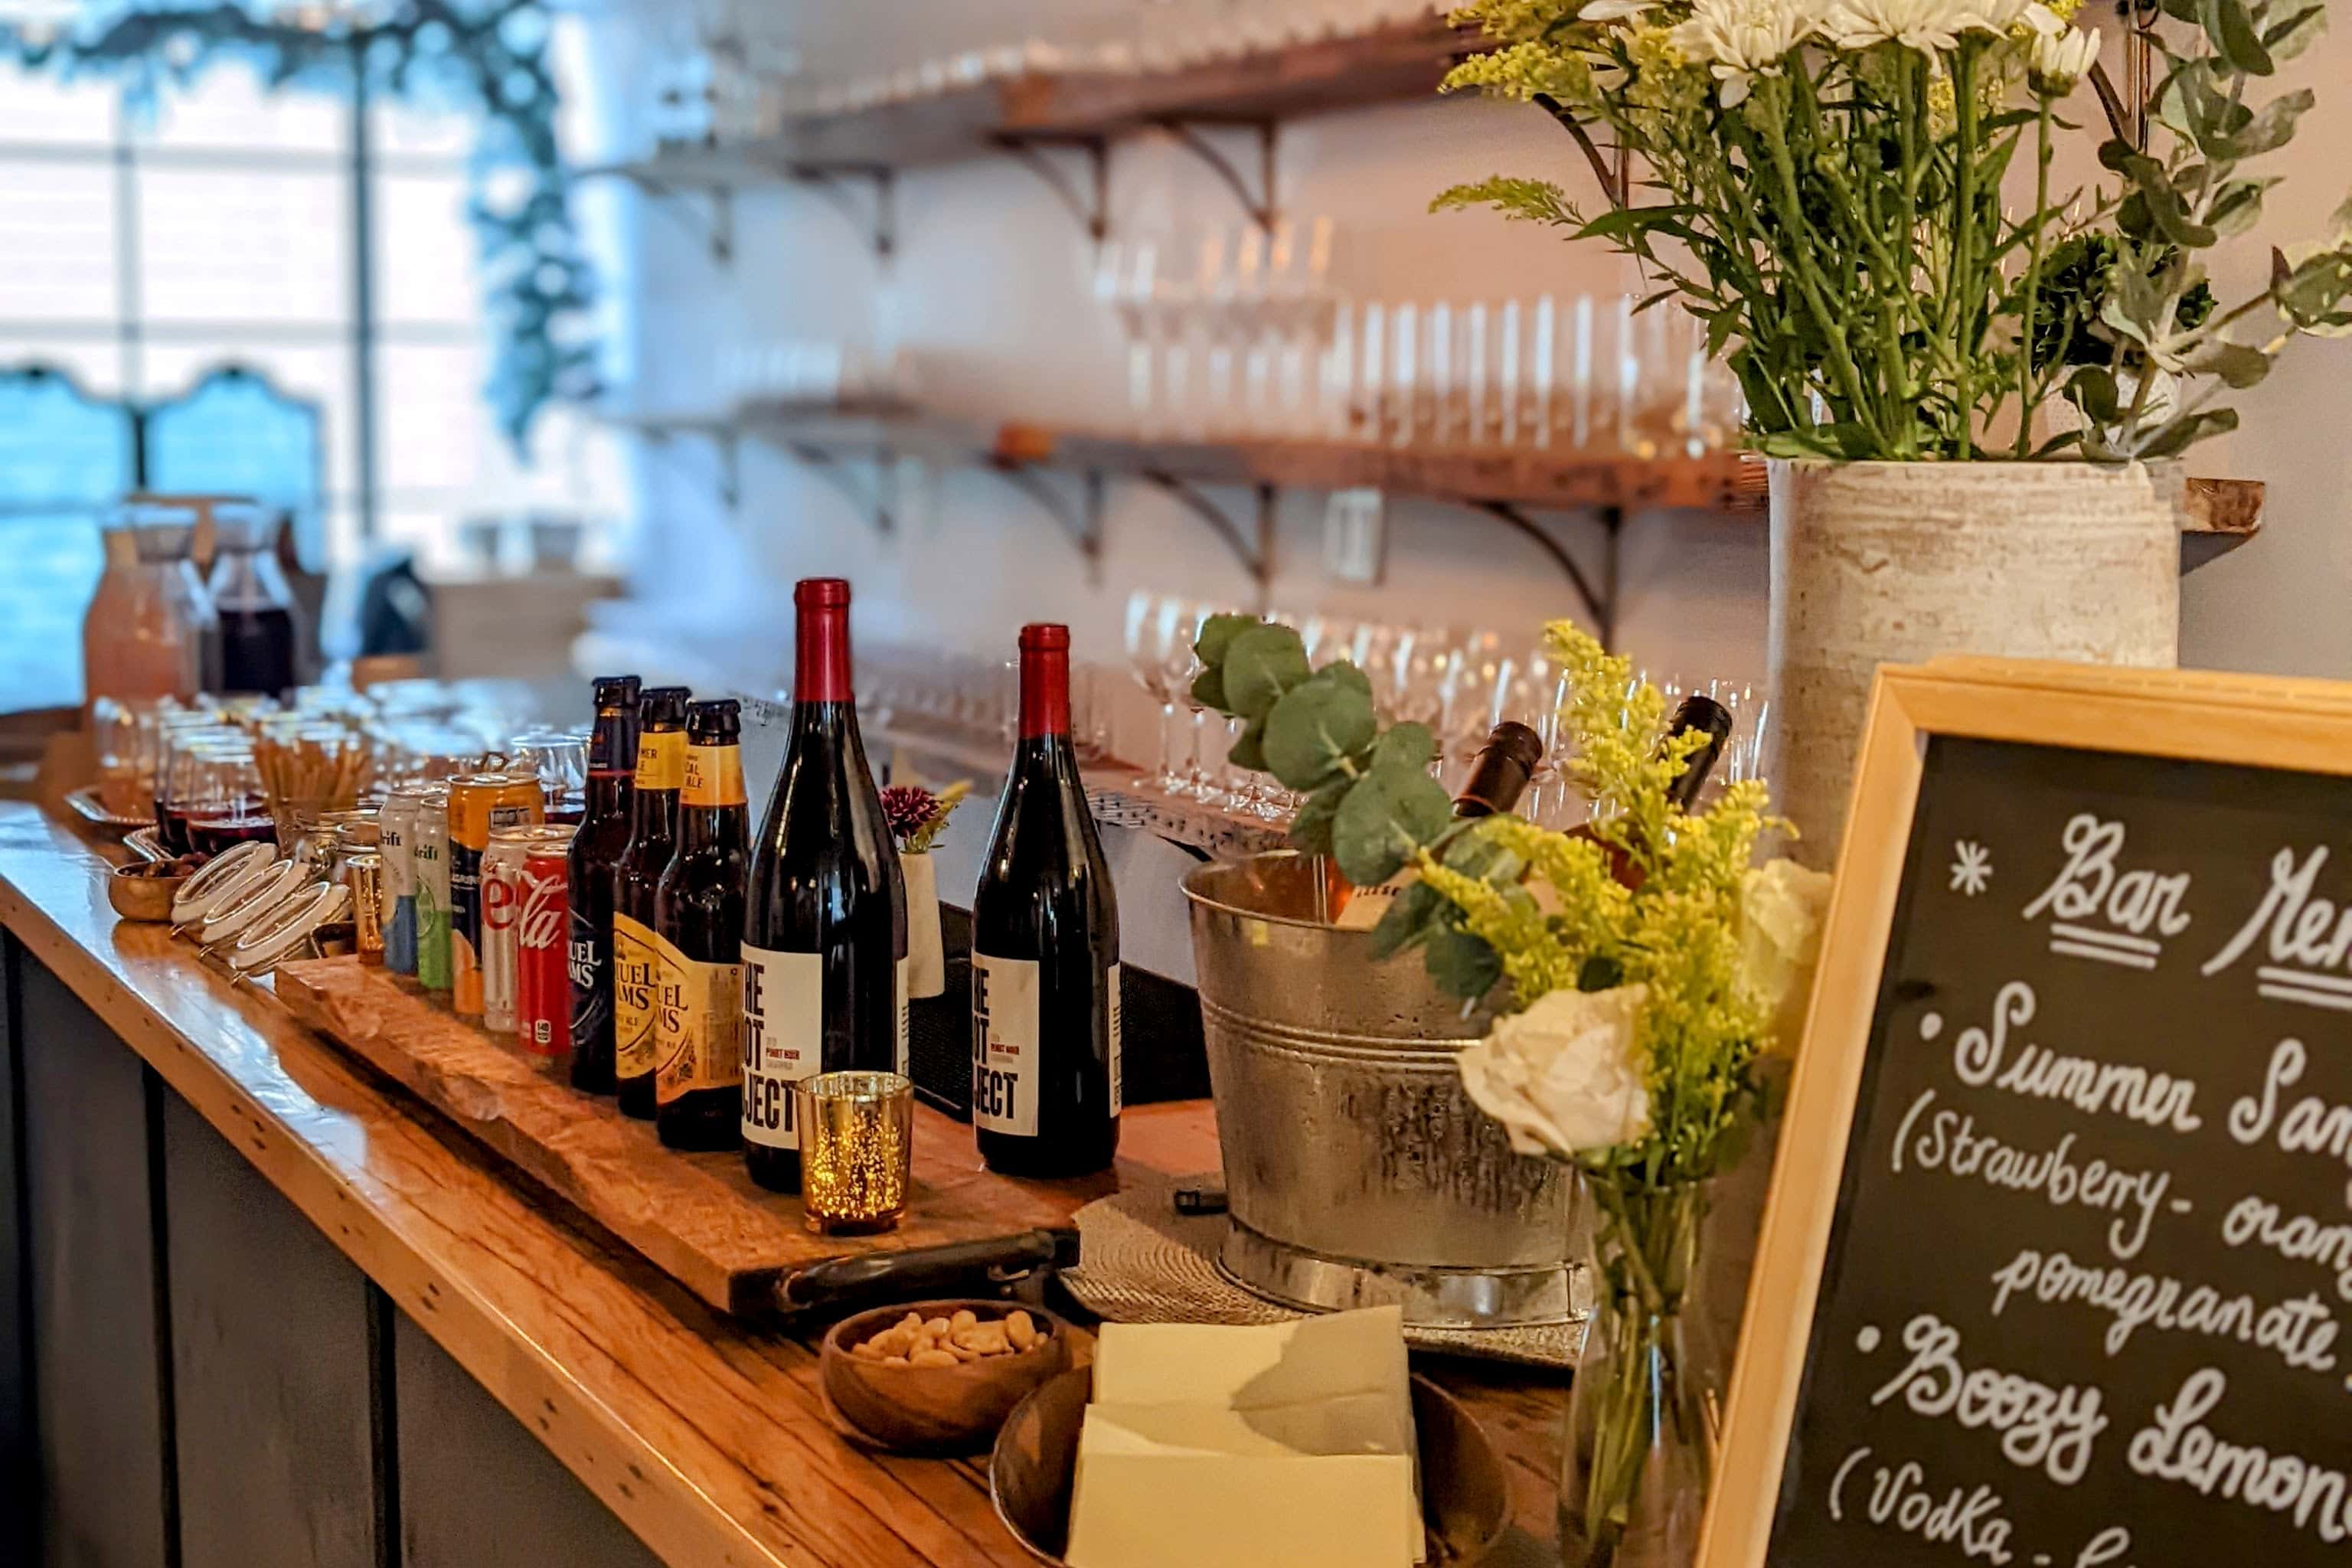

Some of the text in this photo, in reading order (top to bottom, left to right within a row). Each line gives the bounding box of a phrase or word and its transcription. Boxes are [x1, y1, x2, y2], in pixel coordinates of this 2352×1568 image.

[381, 831, 401, 846] rift
[483, 878, 515, 930] e
[519, 874, 565, 949] la
[2023, 814, 2352, 977] Bar Men
[569, 940, 602, 966] UEL
[569, 961, 595, 988] MS
[616, 962, 656, 988] UEL
[618, 983, 649, 1011] MS
[656, 984, 688, 1011] UEL
[743, 962, 765, 1016] HE
[974, 968, 990, 1016] HE
[744, 1016, 765, 1071] OT
[974, 1014, 990, 1065] OT
[743, 1073, 797, 1132] JECT
[975, 1064, 1018, 1119] JECT
[1955, 981, 2352, 1179] Summer San
[2223, 1195, 2352, 1302] oran
[1991, 1250, 2338, 1370] pomegranate
[1870, 1313, 2352, 1544] Boozy Lemon
